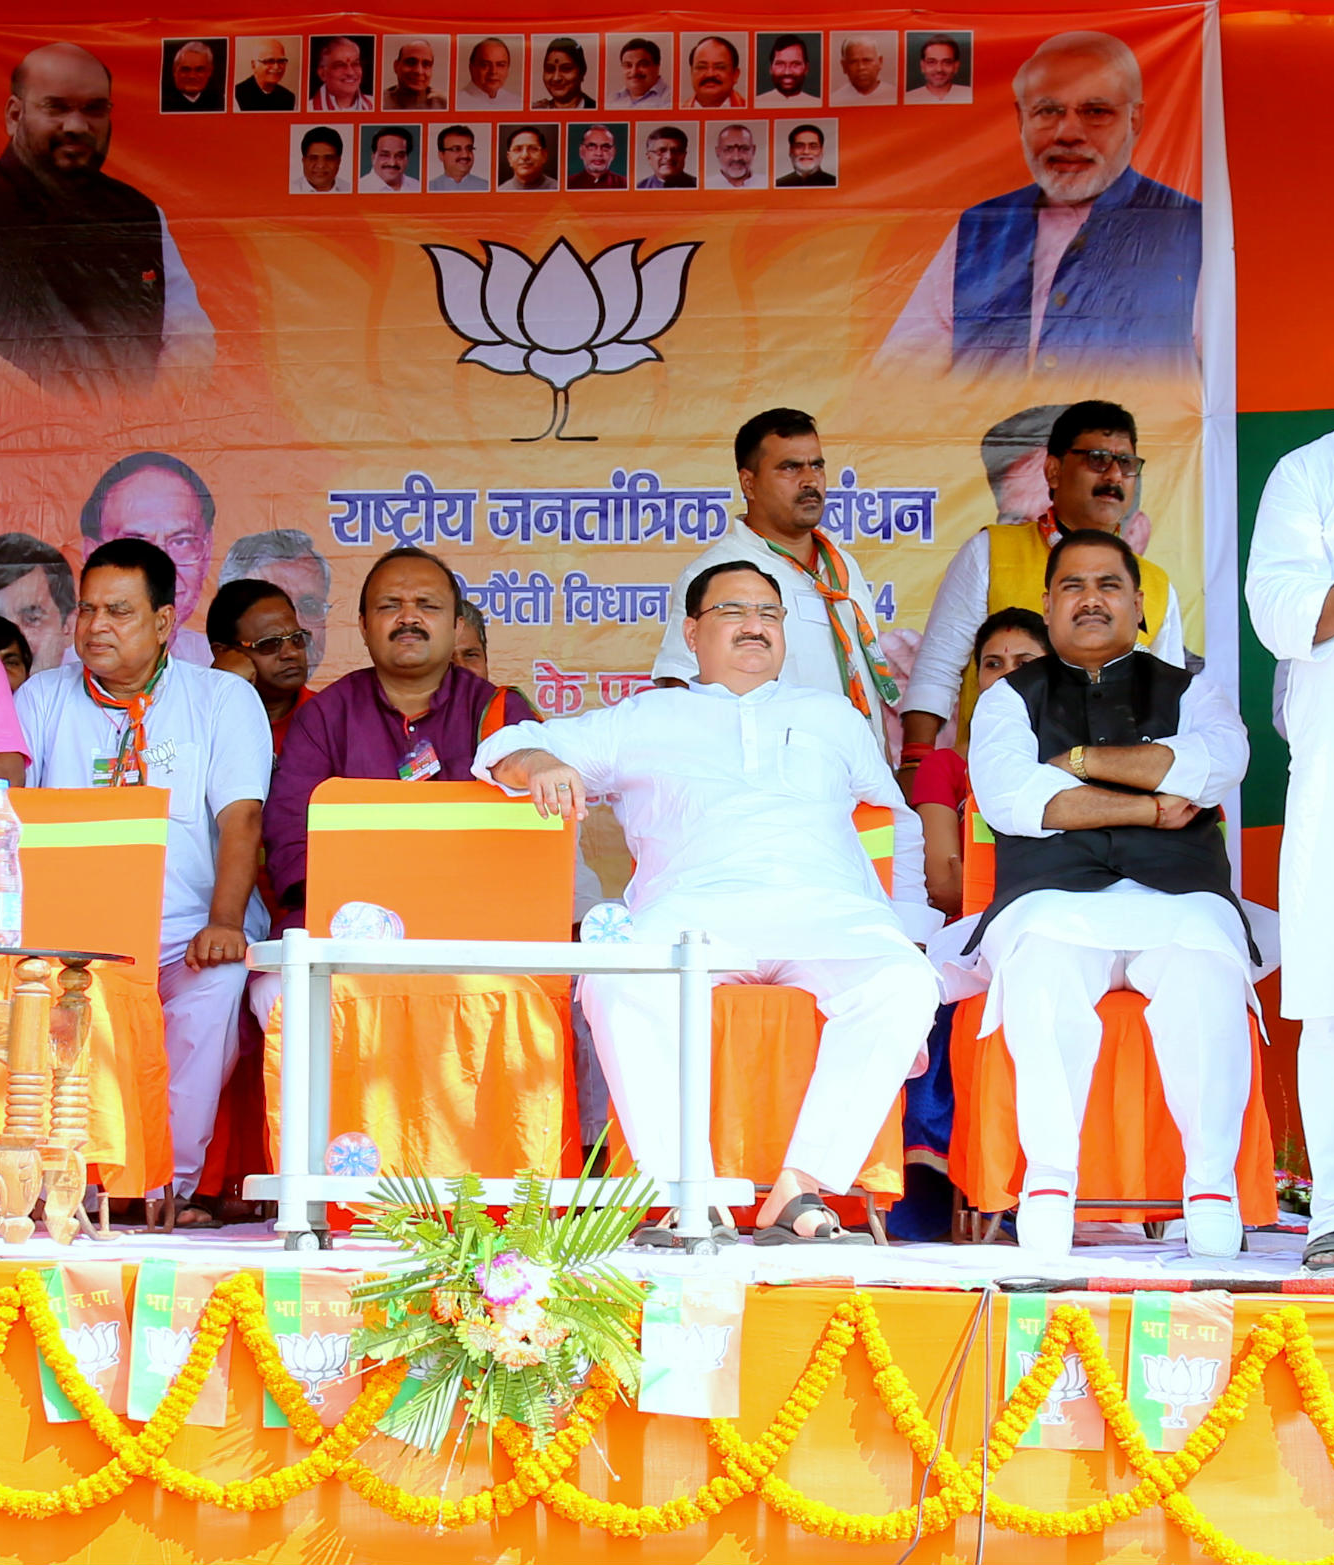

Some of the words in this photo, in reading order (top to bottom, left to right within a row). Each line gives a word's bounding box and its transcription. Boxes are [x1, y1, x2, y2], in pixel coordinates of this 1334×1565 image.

[328, 470, 478, 549] राष्ट्रीय
[486, 466, 733, 545] जनतांत्रिक
[742, 466, 939, 543] बंधन
[453, 569, 555, 625] ीरपैंती
[563, 570, 672, 625] विधान
[533, 660, 588, 716] के
[597, 672, 658, 708] प
